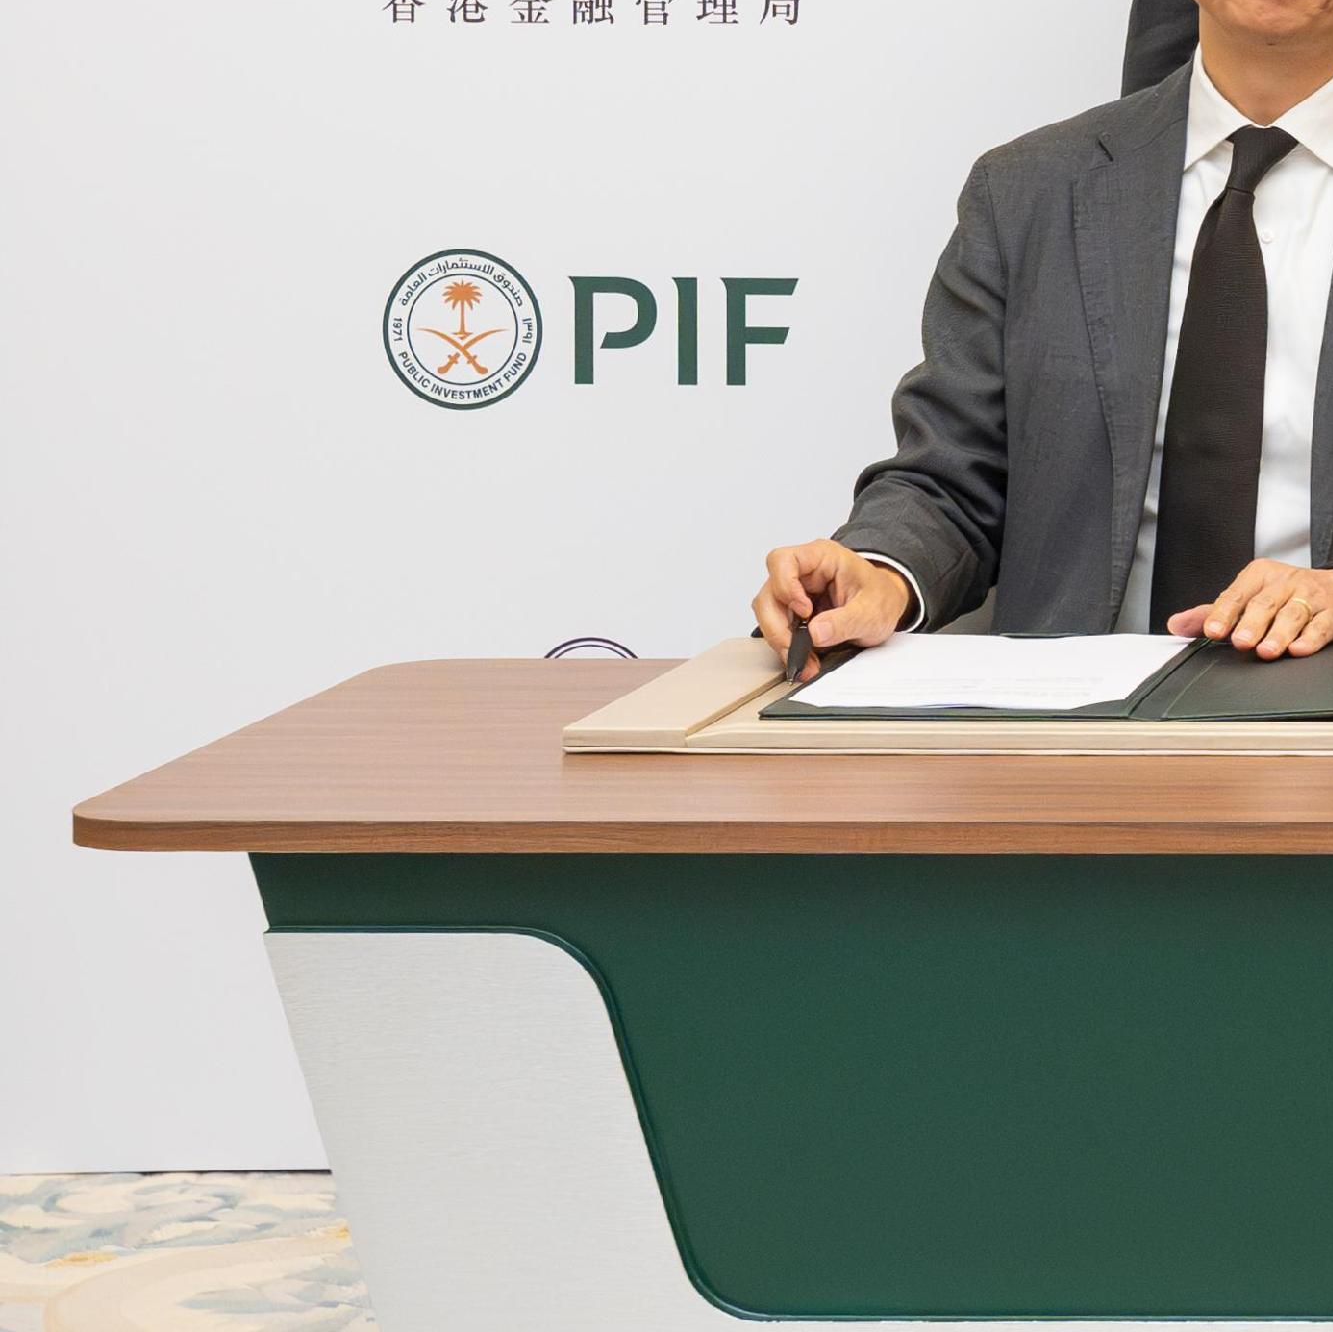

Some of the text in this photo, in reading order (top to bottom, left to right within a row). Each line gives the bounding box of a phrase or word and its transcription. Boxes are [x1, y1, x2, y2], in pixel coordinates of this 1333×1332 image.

[399, 258, 523, 307] صندوق الاستثمارات العامة
[393, 318, 402, 341] 1971
[568, 276, 799, 386] PIF
[399, 351, 527, 399] PUBLIC INVESTMENT FUND
